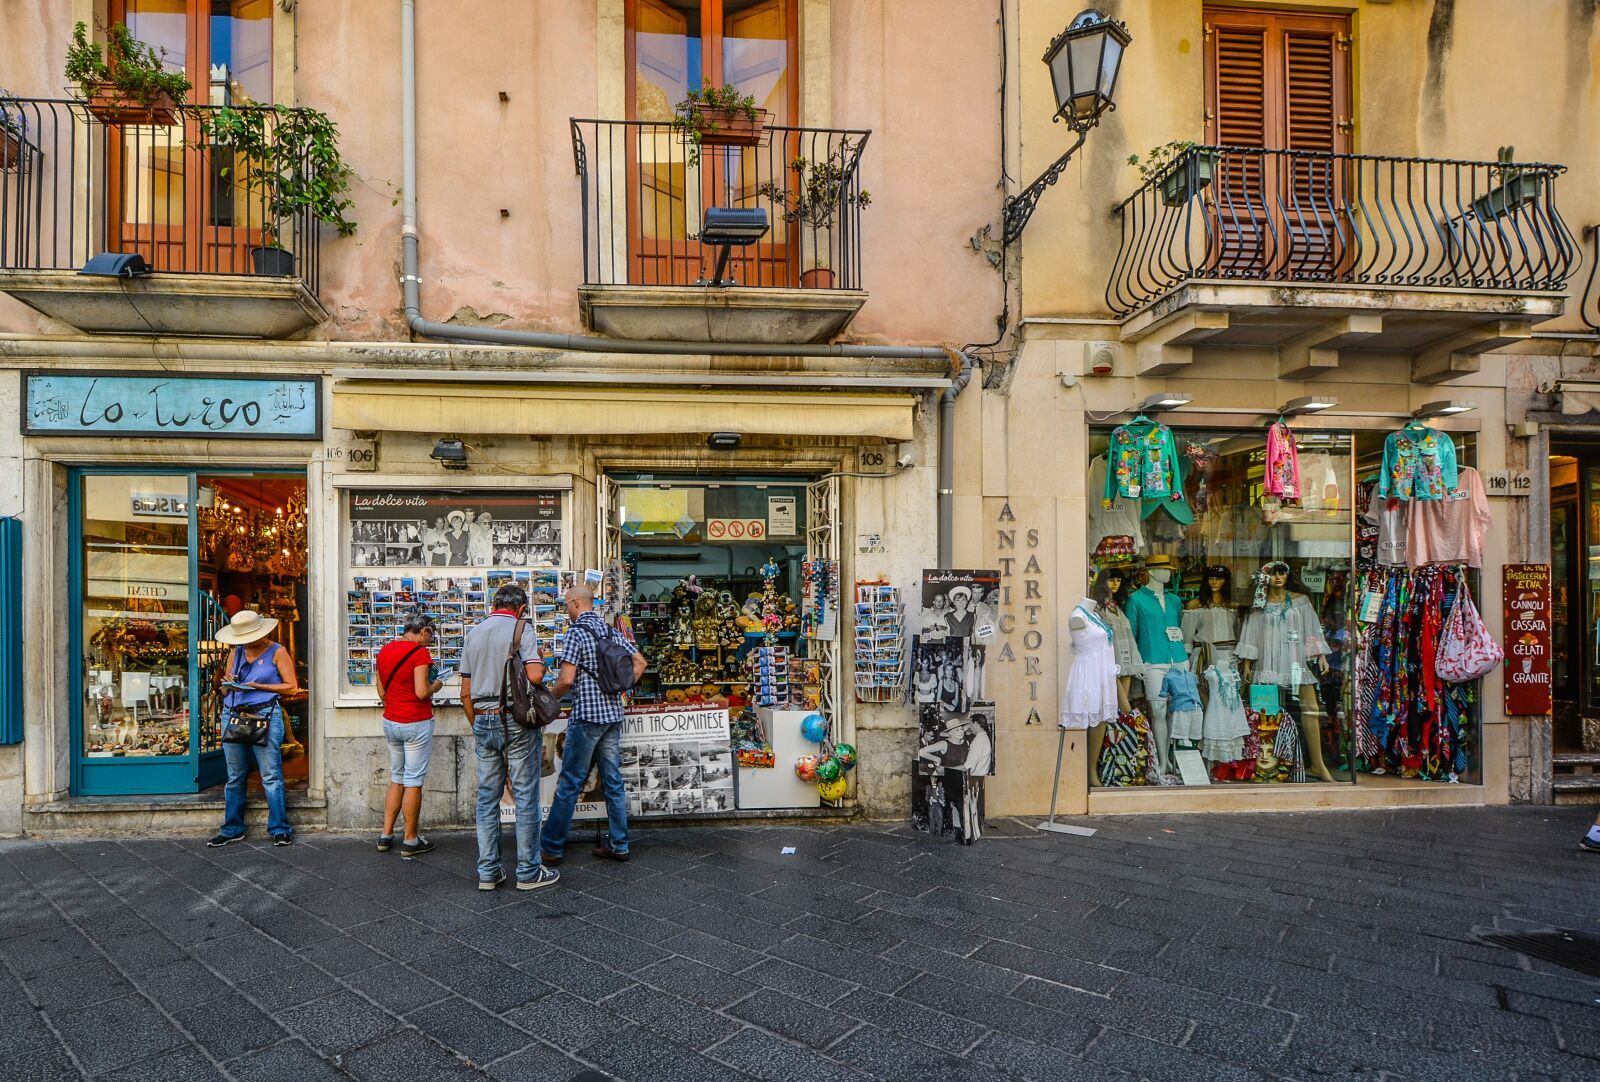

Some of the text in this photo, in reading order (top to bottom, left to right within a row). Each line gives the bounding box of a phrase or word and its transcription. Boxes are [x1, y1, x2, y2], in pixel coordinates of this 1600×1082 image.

[149, 382, 261, 430] Turco
[348, 449, 372, 462] 106
[861, 453, 883, 466] 108
[1489, 477, 1506, 488] 110
[1512, 477, 1531, 488] 112
[355, 494, 427, 506] La dolce vita
[938, 573, 959, 581] dolce
[960, 574, 974, 582] vita
[1516, 580, 1543, 590] ETNA
[1511, 600, 1544, 611] CANNOLI
[998, 502, 1043, 726] ANTICA SARTORIA
[1511, 620, 1547, 631] CASSATA
[1513, 645, 1544, 656] GELATI
[1513, 673, 1549, 684] GRANITE
[665, 703, 701, 712] photographic
[649, 712, 724, 732] TAORMINESE
[576, 804, 597, 812] EDEN
